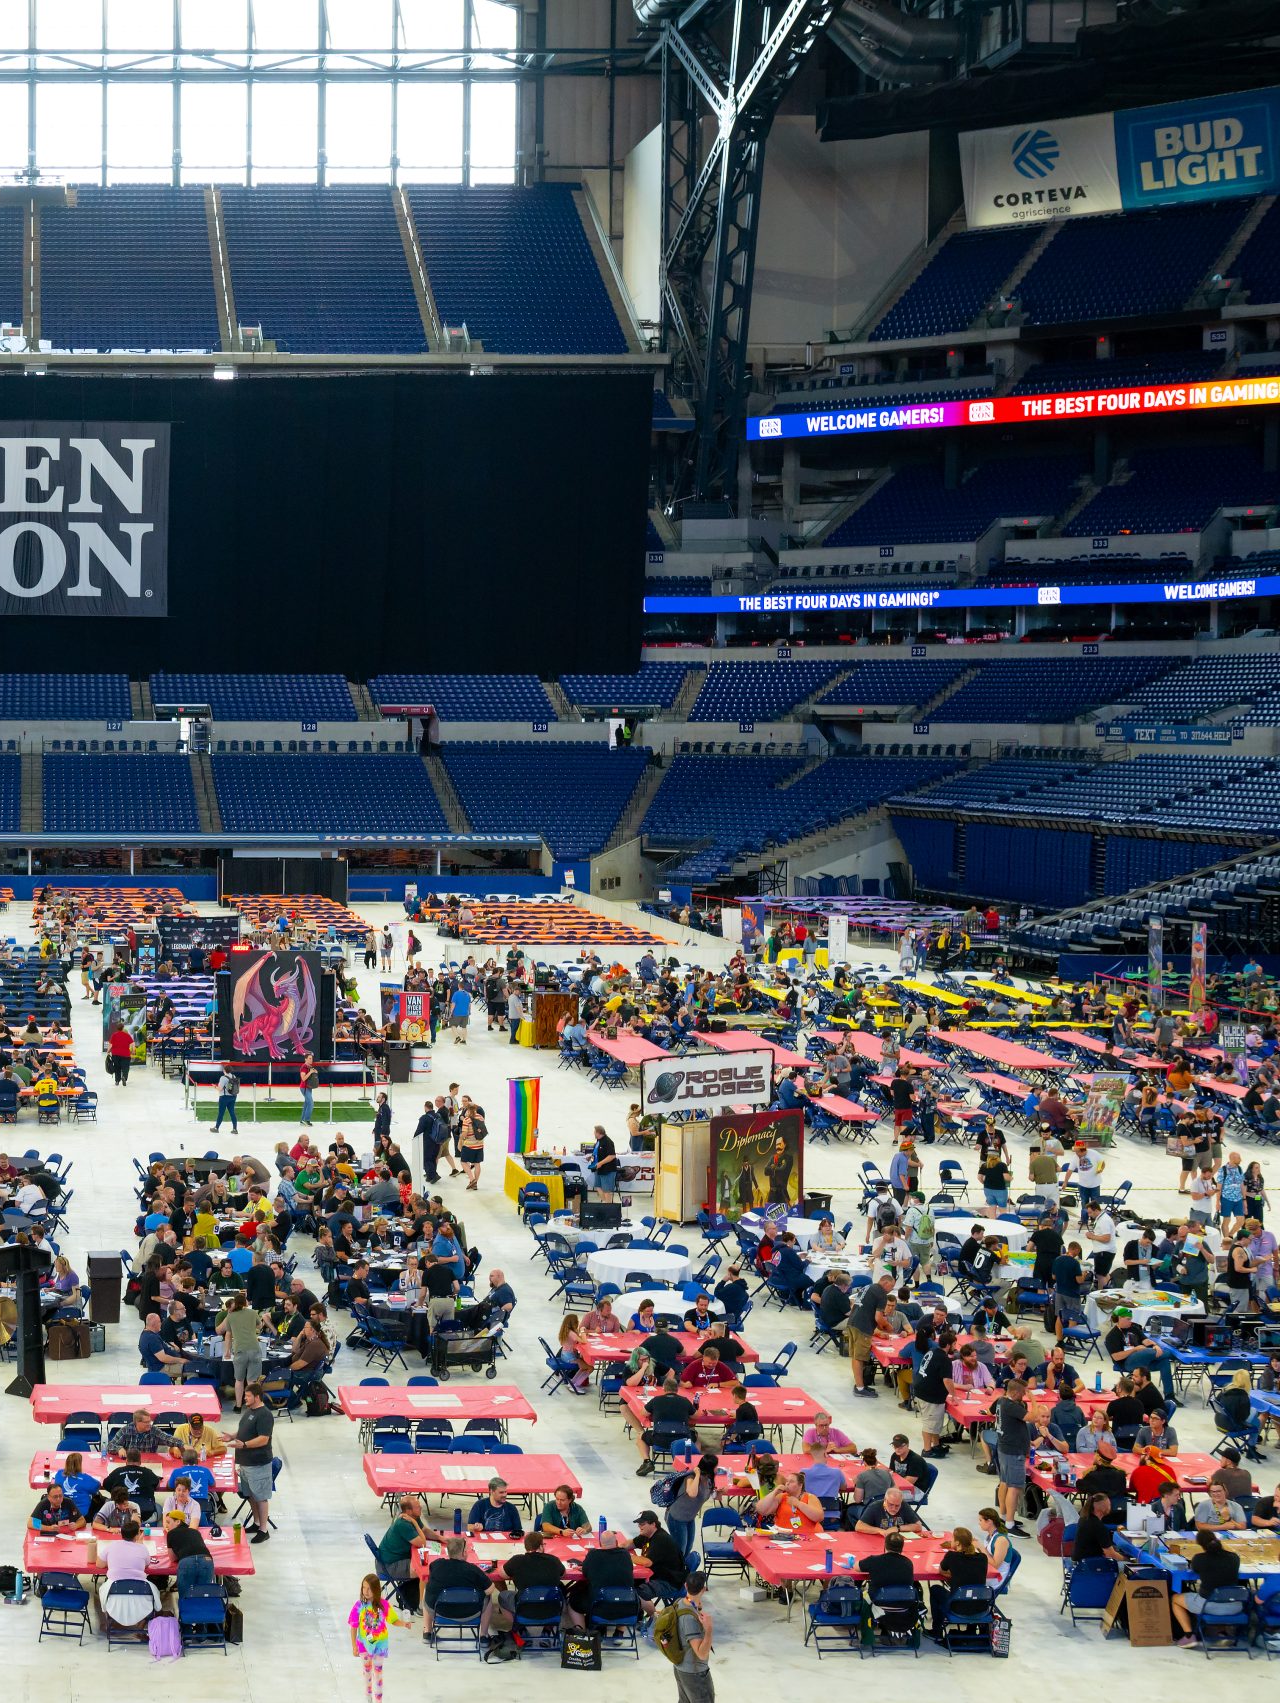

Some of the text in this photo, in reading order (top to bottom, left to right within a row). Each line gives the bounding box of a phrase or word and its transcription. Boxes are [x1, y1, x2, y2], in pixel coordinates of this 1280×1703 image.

[1154, 117, 1244, 158] BUD
[1140, 145, 1263, 191] LIGHT
[993, 187, 1087, 209] CORTEVA
[1012, 205, 1071, 220] agriscience
[1022, 399, 1051, 416] THE
[1055, 396, 1095, 414] BEST
[1098, 392, 1140, 411] FOUR
[1143, 389, 1186, 408] DAYS
[1189, 387, 1207, 404] IN
[807, 407, 944, 432] WELCOME GAMERS!
[649, 554, 663, 562] 330
[880, 548, 893, 556] 331
[1164, 580, 1256, 600] WELCOME GAMERS!
[739, 597, 761, 610] THE
[764, 596, 793, 609] BEST
[796, 595, 827, 608] FOUR
[830, 594, 860, 607] DAYS
[863, 594, 876, 606] IN
[778, 649, 791, 657] 231
[740, 724, 753, 732] 132
[914, 725, 928, 733] 132
[1134, 729, 1156, 740] TEXT
[407, 996, 422, 1005] VAN
[1223, 1026, 1245, 1036] BLACK
[1224, 1037, 1245, 1048] HATS
[686, 1065, 763, 1084] ROGUE
[678, 1080, 765, 1099] JUDGES
[719, 1120, 777, 1158] Diplomacy
